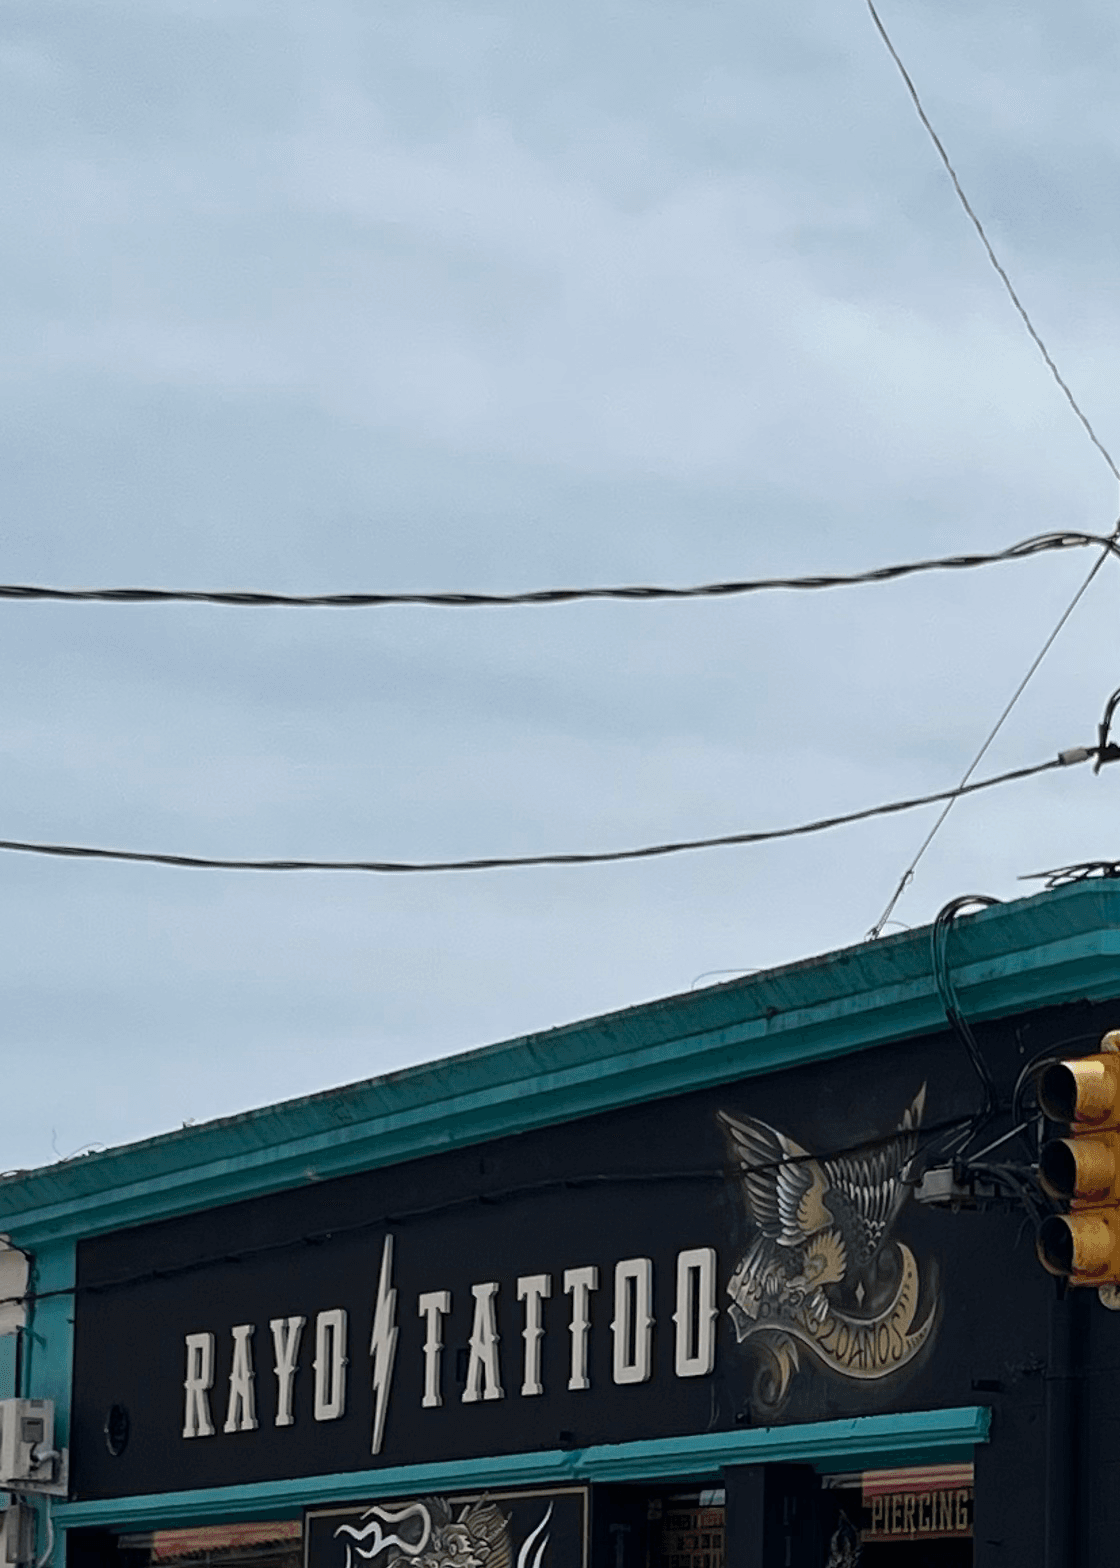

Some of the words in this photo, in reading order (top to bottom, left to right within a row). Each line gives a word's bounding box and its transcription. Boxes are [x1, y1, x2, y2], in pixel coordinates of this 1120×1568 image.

[182, 1308, 349, 1438] RAYO
[417, 1247, 719, 1408] TATTOO
[870, 1488, 970, 1535] PIERCING
